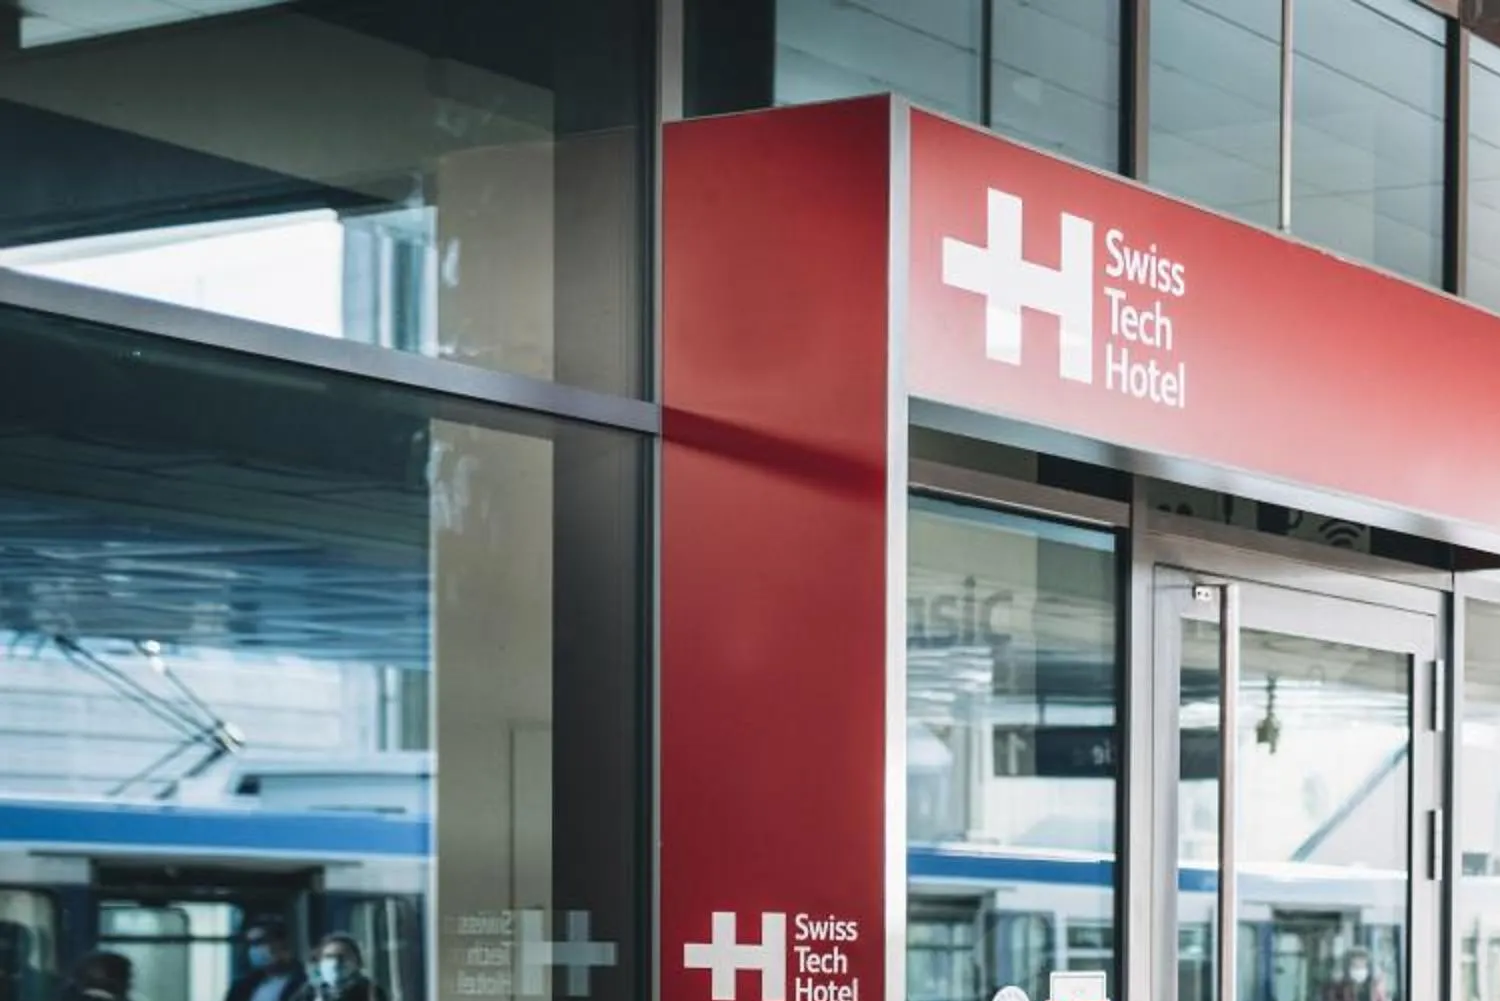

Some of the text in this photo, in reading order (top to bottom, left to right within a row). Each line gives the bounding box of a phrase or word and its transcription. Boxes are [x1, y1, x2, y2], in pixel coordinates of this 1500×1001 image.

[1105, 228, 1185, 297] Swiss
[1104, 287, 1173, 350] Tech
[1105, 344, 1185, 408] Hotel
[795, 913, 858, 941] Swiss
[794, 945, 848, 974] Tech
